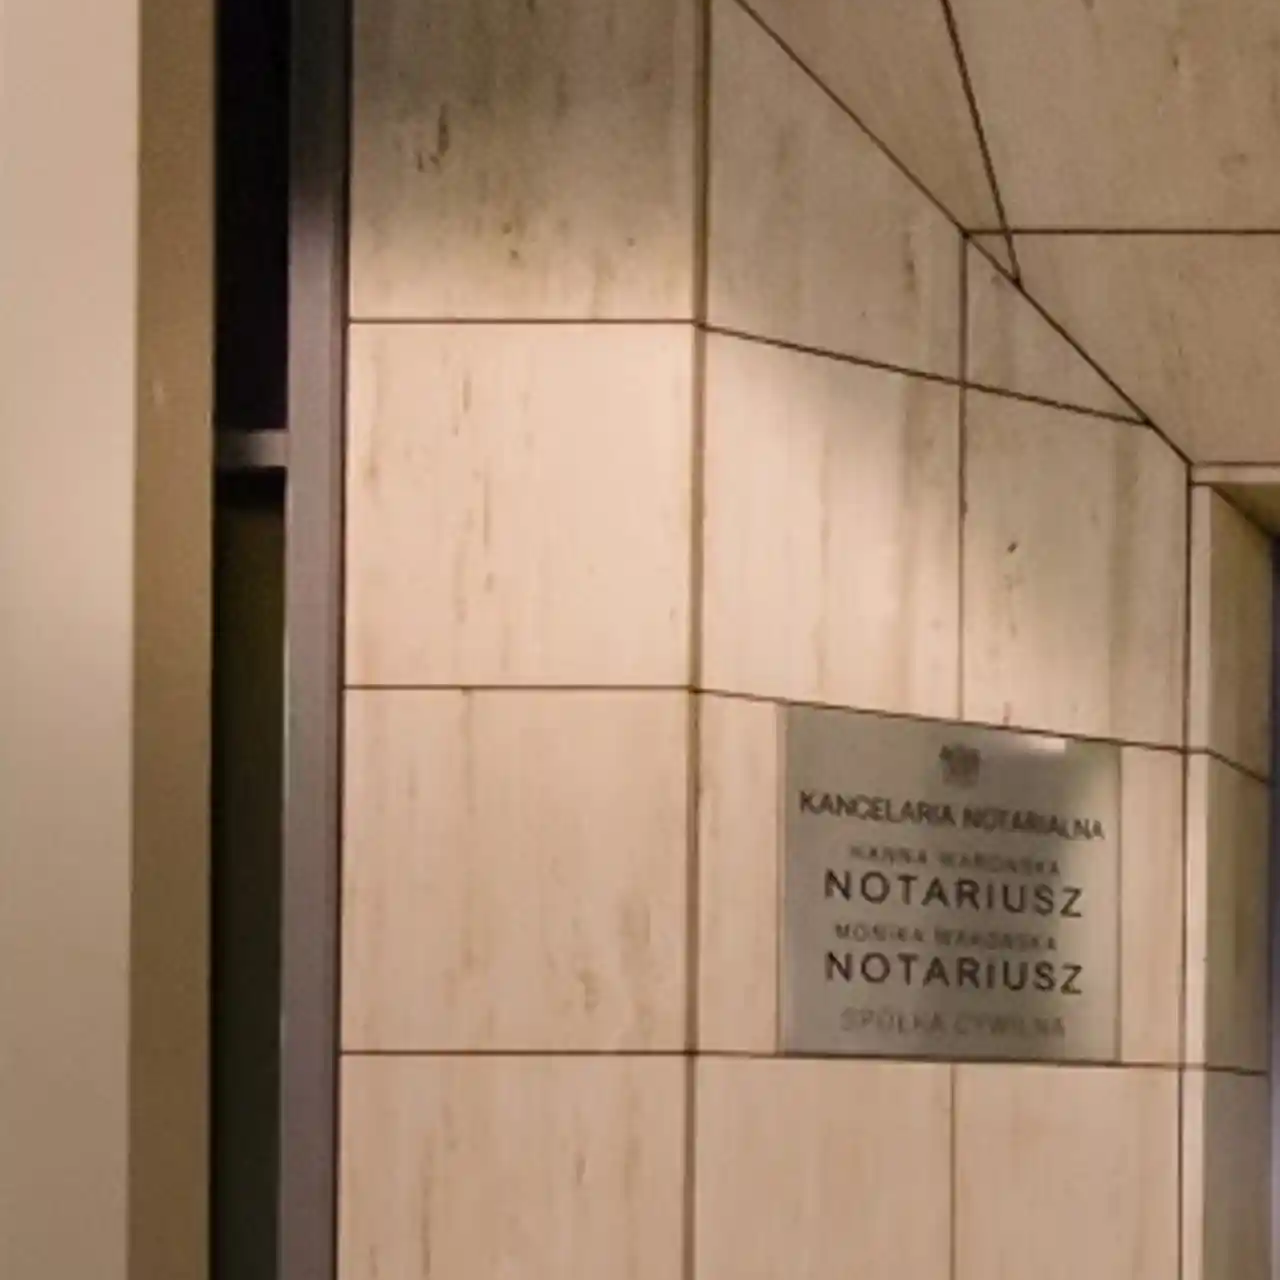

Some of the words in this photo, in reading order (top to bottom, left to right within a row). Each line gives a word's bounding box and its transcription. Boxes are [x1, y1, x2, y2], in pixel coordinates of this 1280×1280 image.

[799, 789, 956, 827] KANCELARIA
[963, 806, 1105, 841] NOTARIALNA
[824, 868, 1082, 918] NOTARIUSZ
[824, 950, 1083, 995] NOTARIUSZ
